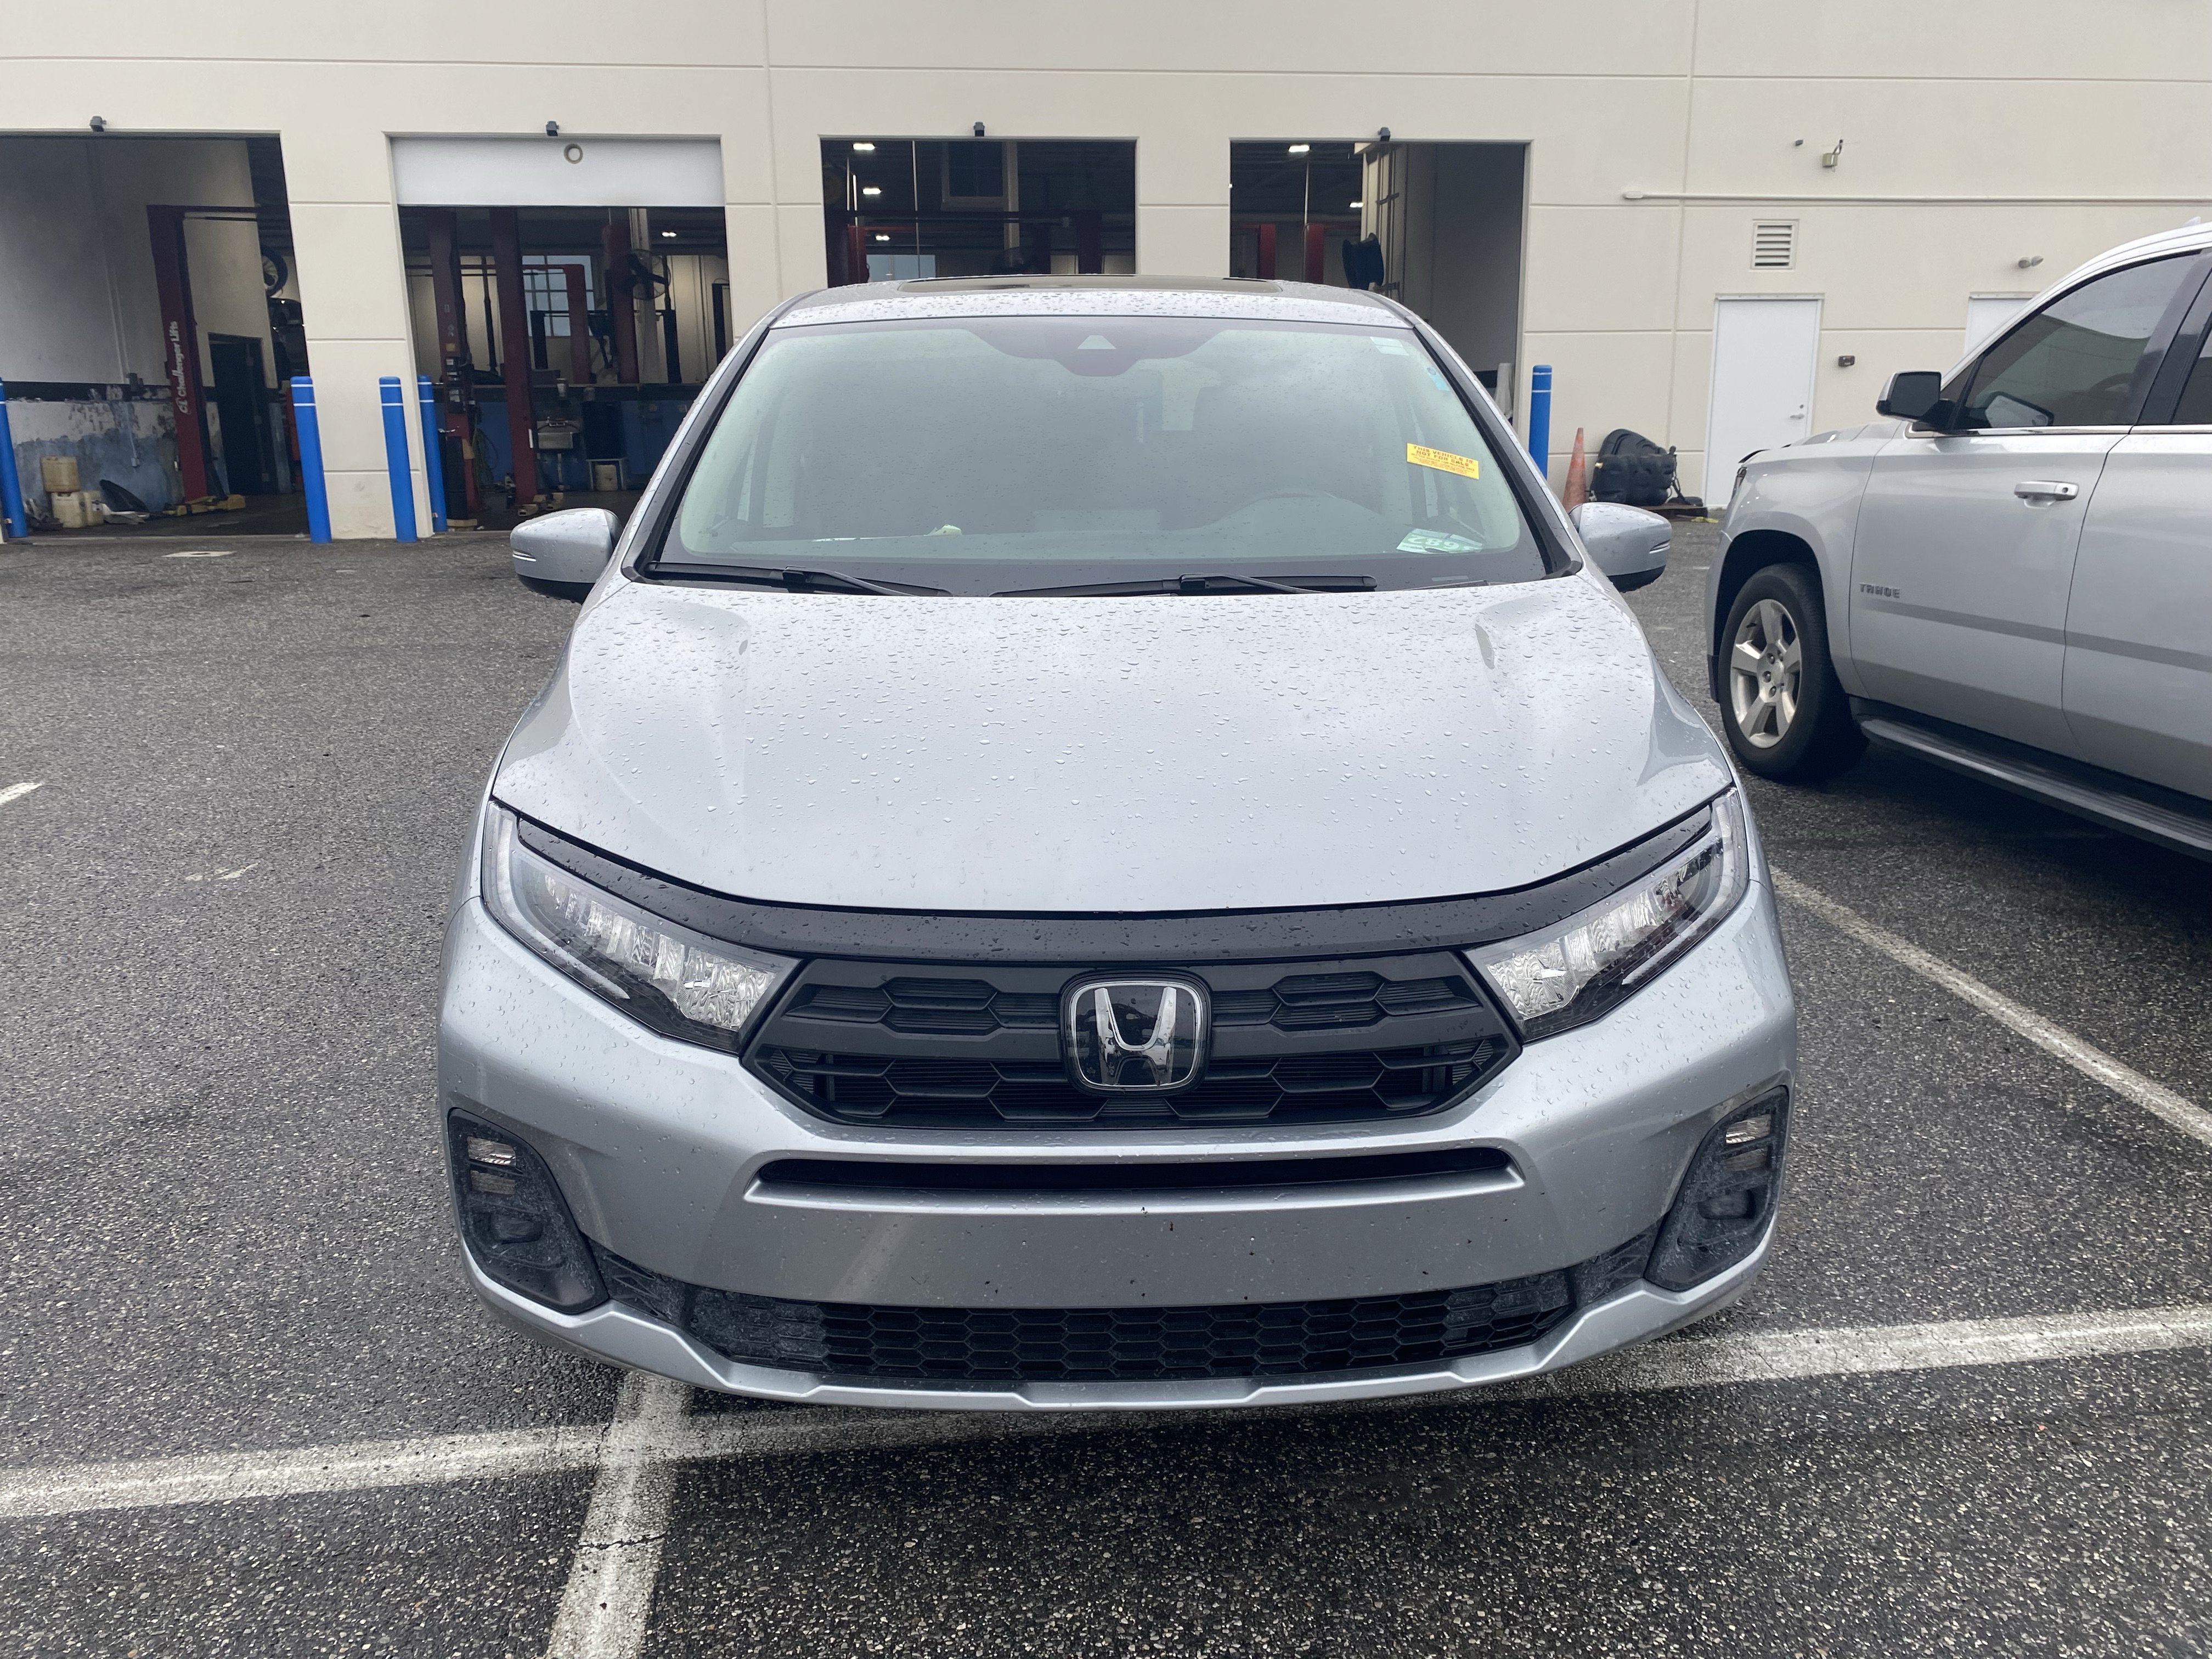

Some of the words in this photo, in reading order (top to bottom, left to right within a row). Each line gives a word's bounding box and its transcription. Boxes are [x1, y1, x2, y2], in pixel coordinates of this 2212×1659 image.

[170, 321, 180, 342] Lifts
[171, 342, 187, 397] Challenger
[1413, 445, 1430, 453] THIS
[1432, 450, 1463, 461] VEHICLE
[1451, 459, 1469, 467] SALE
[1860, 583, 1900, 599] TAHOE
